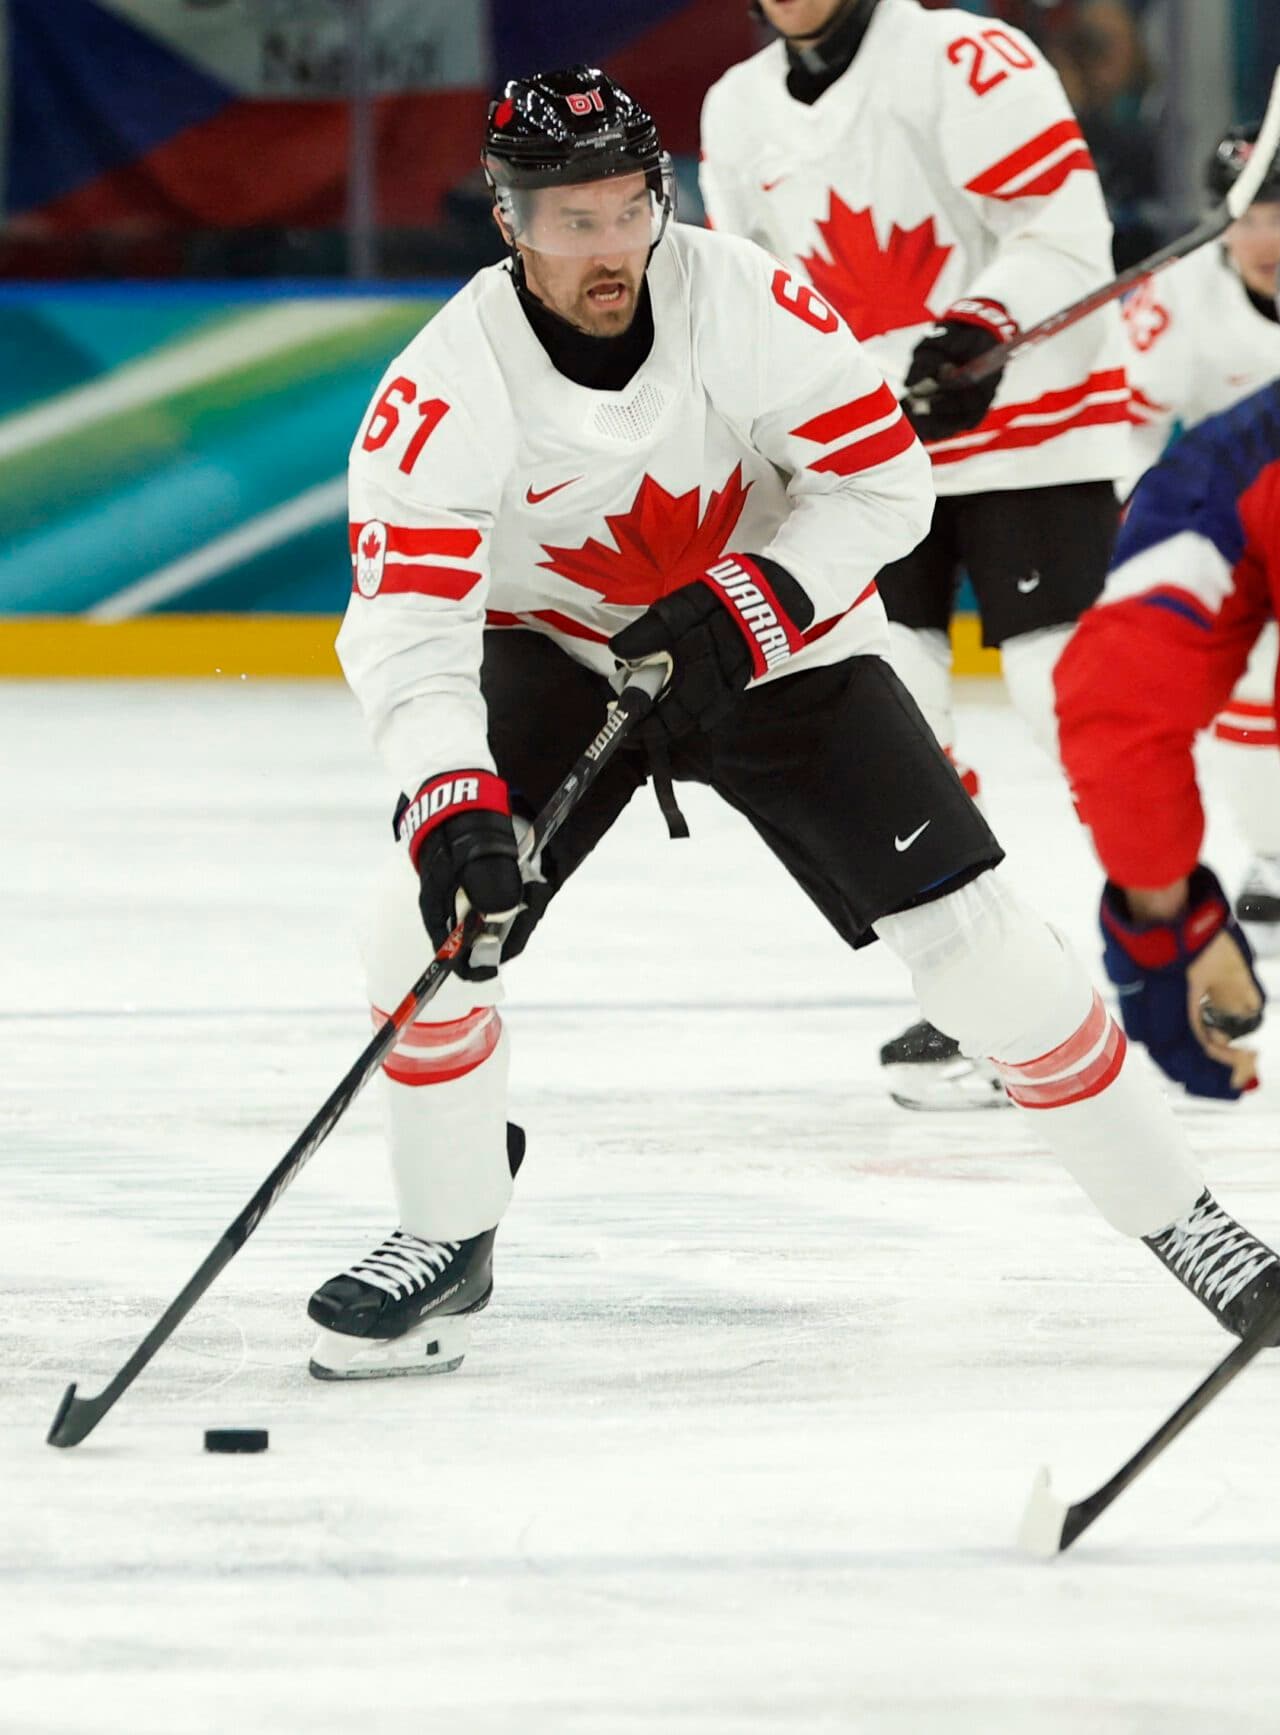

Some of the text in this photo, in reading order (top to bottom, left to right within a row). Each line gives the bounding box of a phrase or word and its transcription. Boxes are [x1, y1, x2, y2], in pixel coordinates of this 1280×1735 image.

[947, 29, 1036, 97] 20
[770, 269, 840, 335] 6
[361, 375, 451, 476] 61
